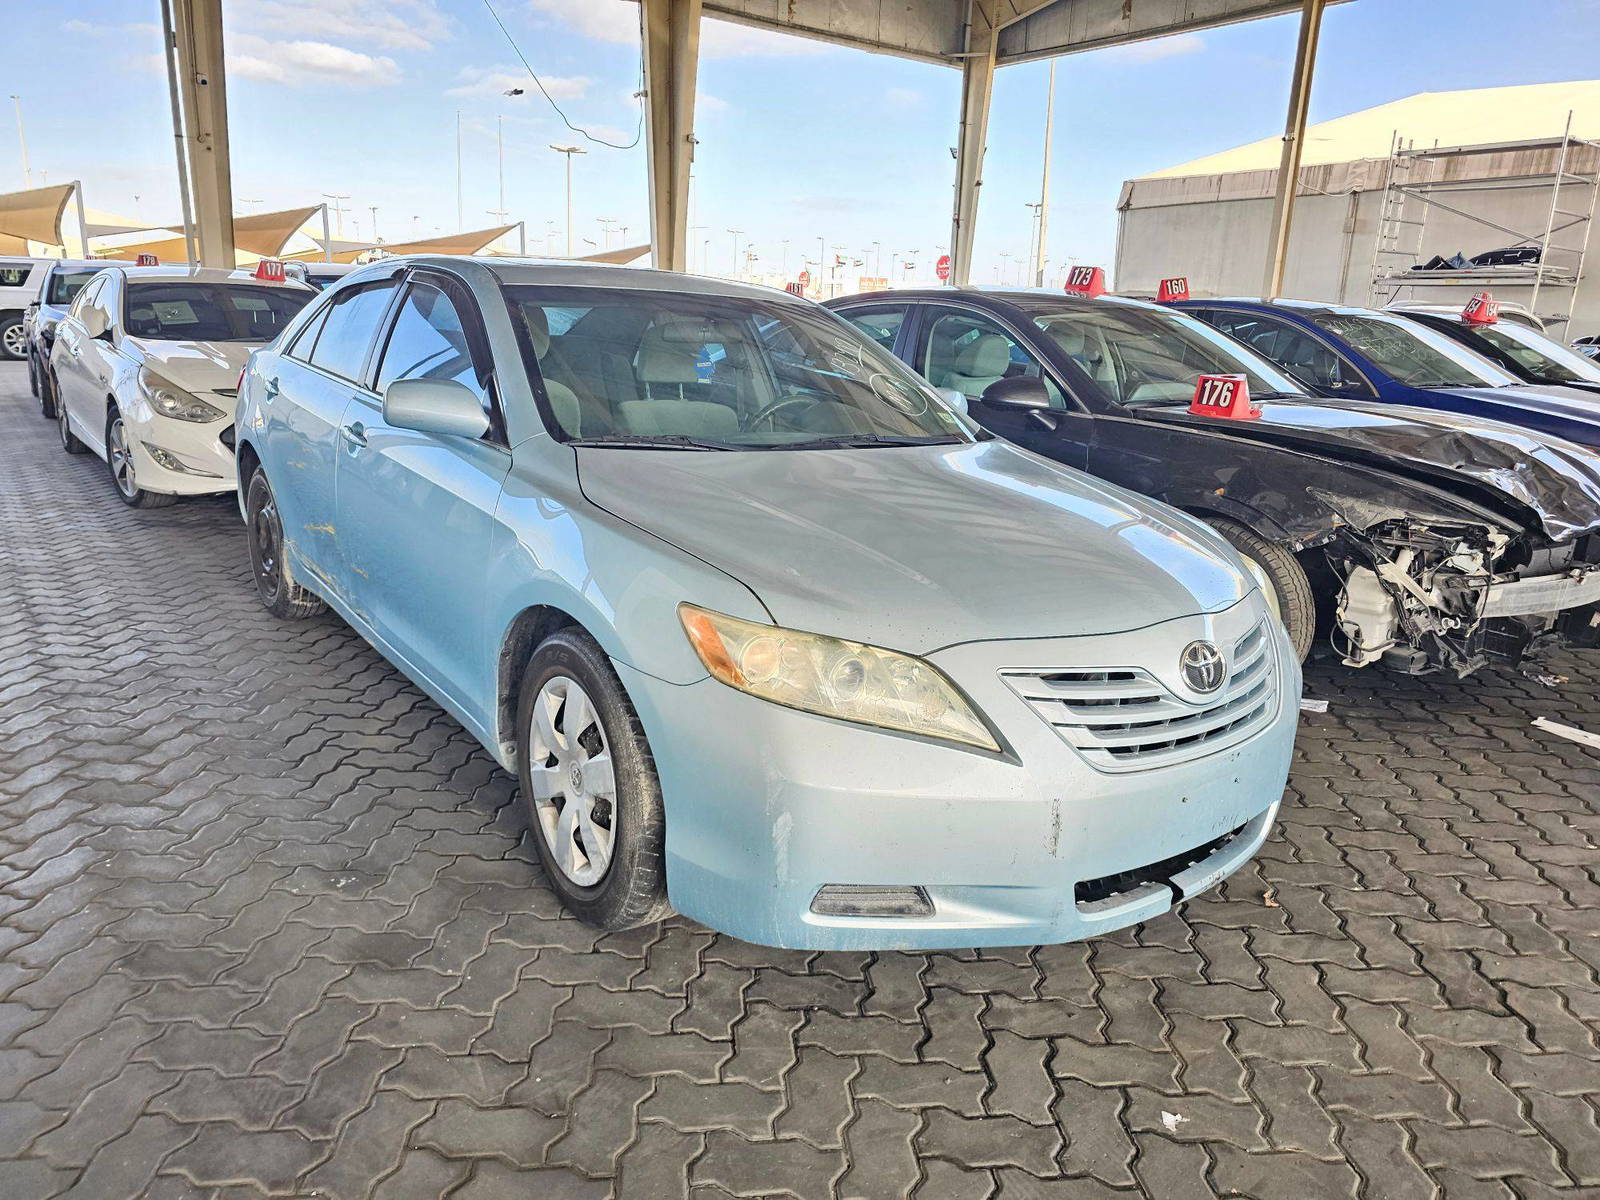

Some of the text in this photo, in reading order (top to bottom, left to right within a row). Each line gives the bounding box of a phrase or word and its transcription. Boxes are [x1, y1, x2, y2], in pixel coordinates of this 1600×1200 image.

[142, 255, 156, 266] 178
[266, 263, 282, 276] 177
[1071, 268, 1093, 285] 173
[1166, 279, 1186, 295] 160
[1201, 379, 1234, 408] 176
